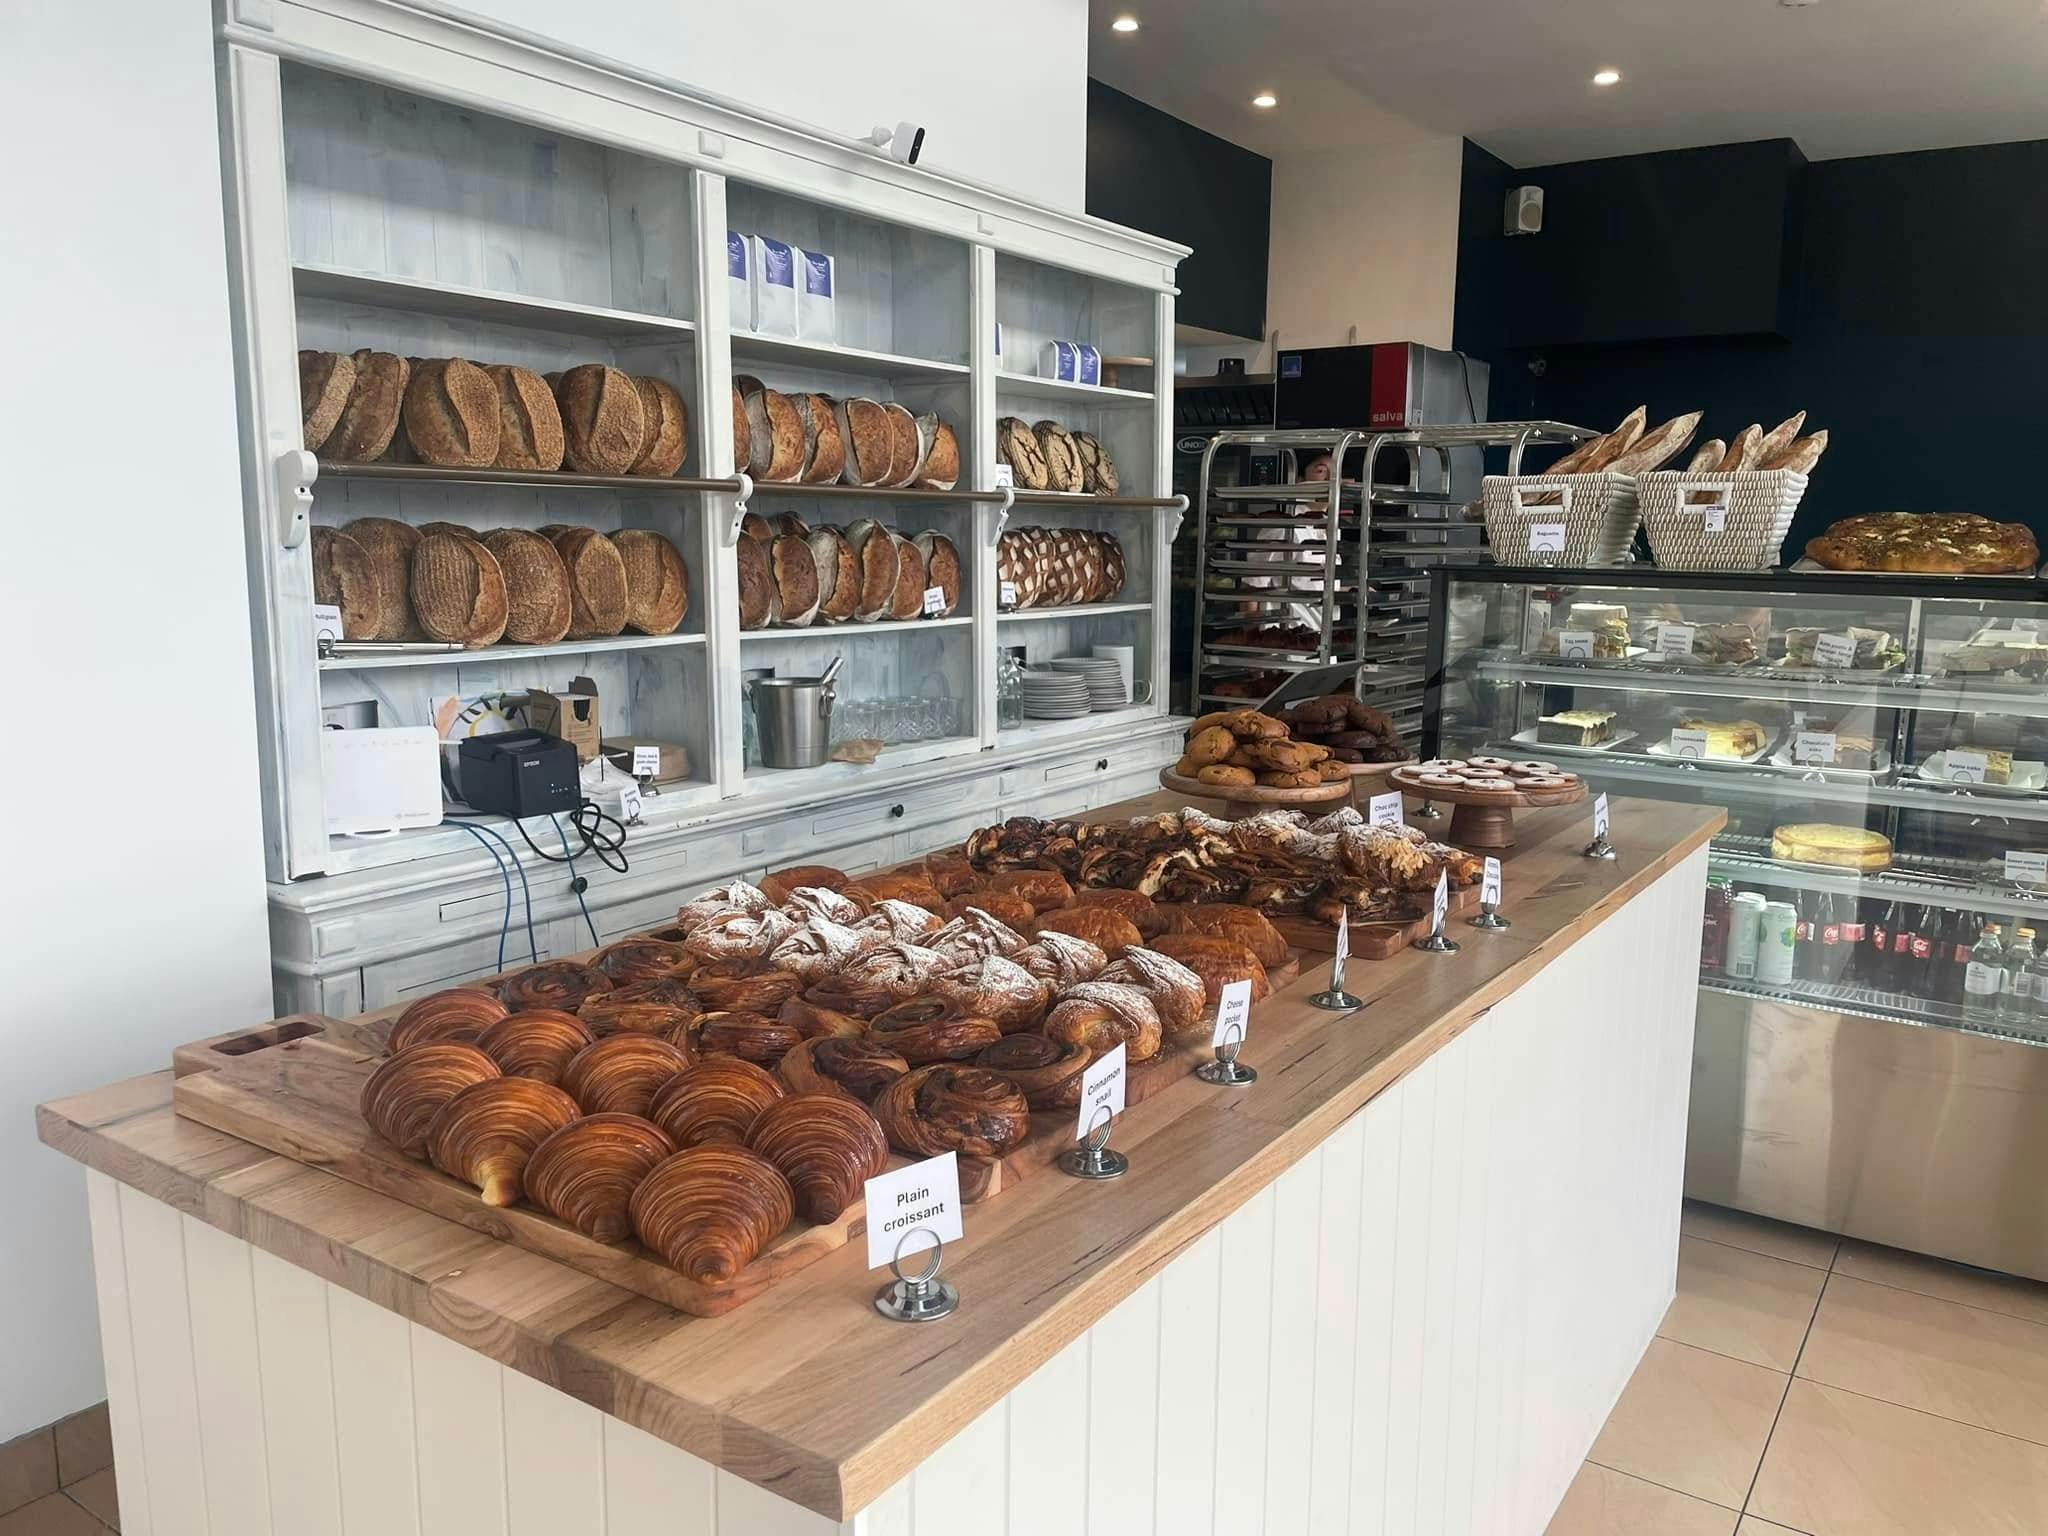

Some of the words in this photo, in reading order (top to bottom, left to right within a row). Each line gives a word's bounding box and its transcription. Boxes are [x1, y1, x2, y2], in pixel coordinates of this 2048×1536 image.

[1373, 411, 1403, 422] salva
[1388, 801, 1399, 809] chip
[1087, 1067, 1121, 1096] Cinnamon
[1095, 1087, 1112, 1106] snail
[896, 1187, 930, 1208] Plain
[883, 1202, 945, 1233] croissant
